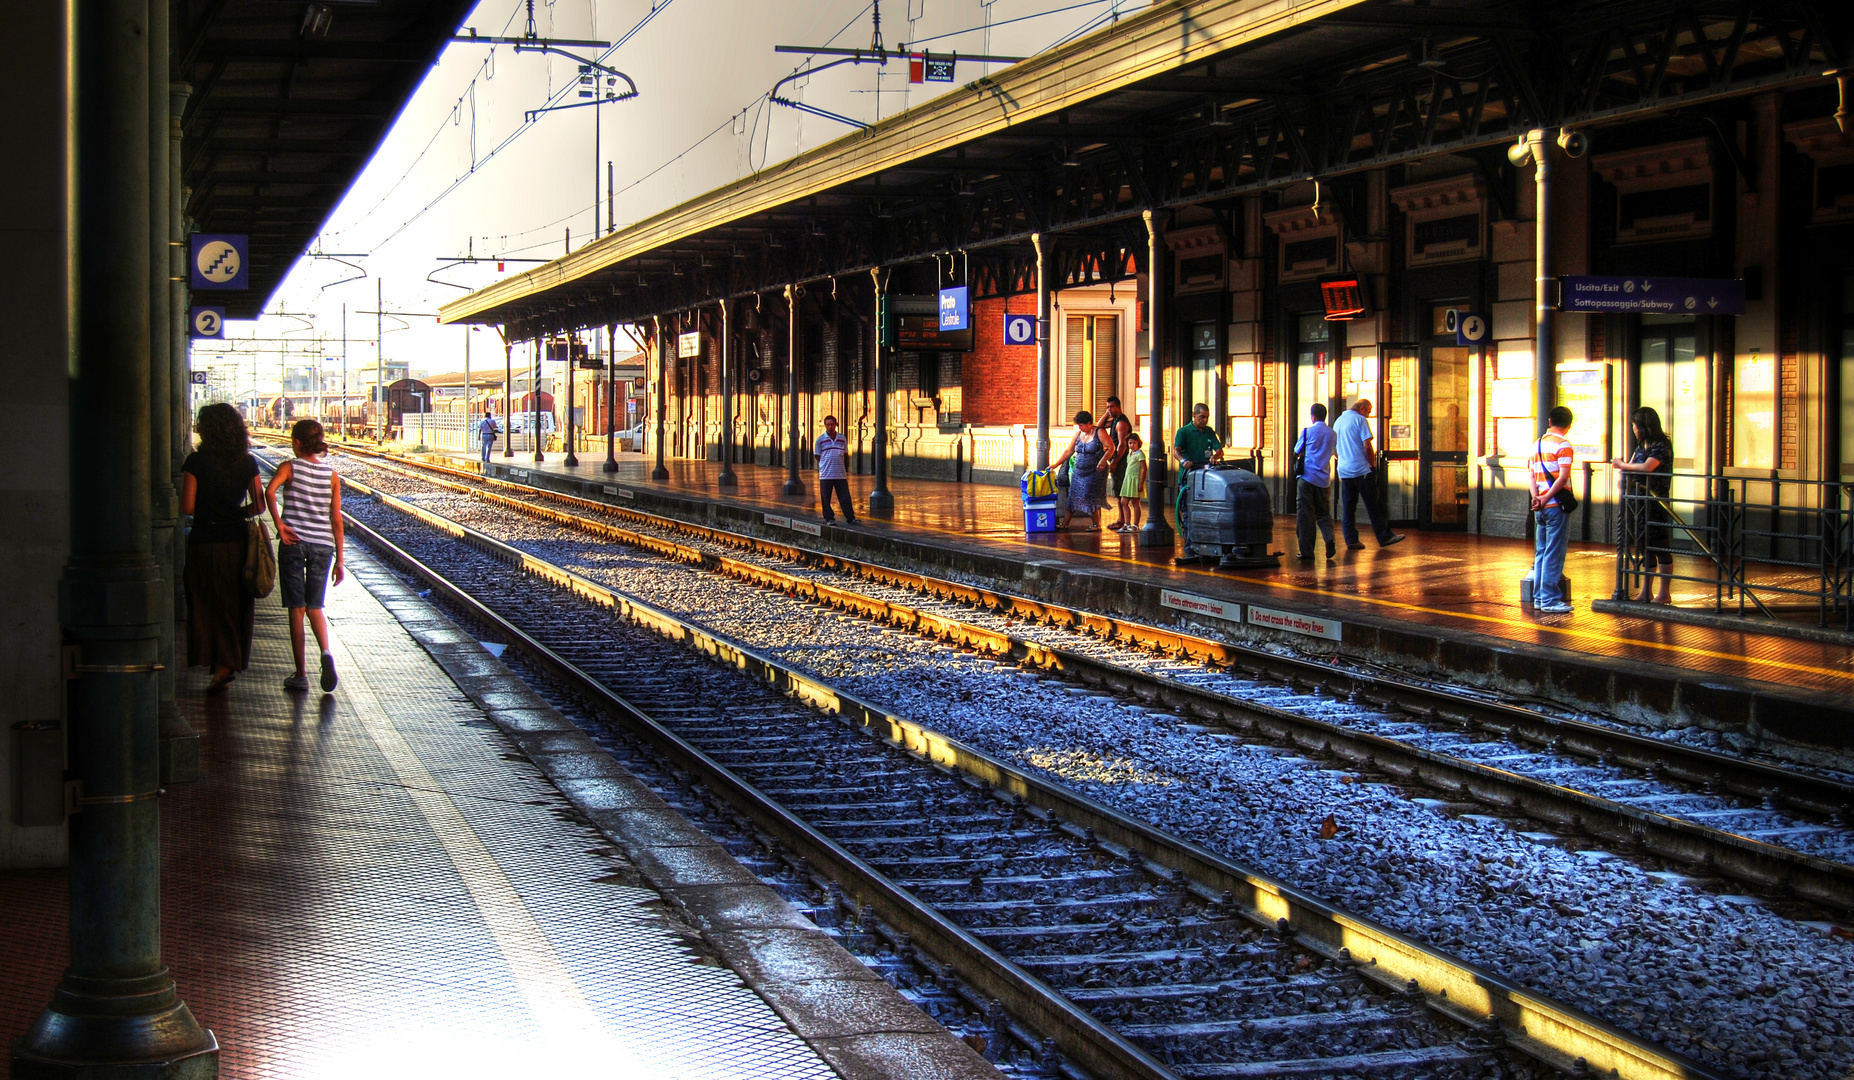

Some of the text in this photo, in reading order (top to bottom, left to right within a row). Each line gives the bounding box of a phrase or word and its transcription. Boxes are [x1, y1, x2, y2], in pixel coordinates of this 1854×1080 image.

[1575, 283, 1620, 293] Uscita/Exit
[941, 294, 956, 310] Prato
[1574, 298, 1674, 310] Sottopassaggio/Subway
[202, 314, 216, 332] 2
[900, 318, 905, 327] 1
[941, 309, 960, 327] Centrale
[1016, 322, 1024, 338] 1
[1255, 610, 1324, 634] Do not cross the railway lines
